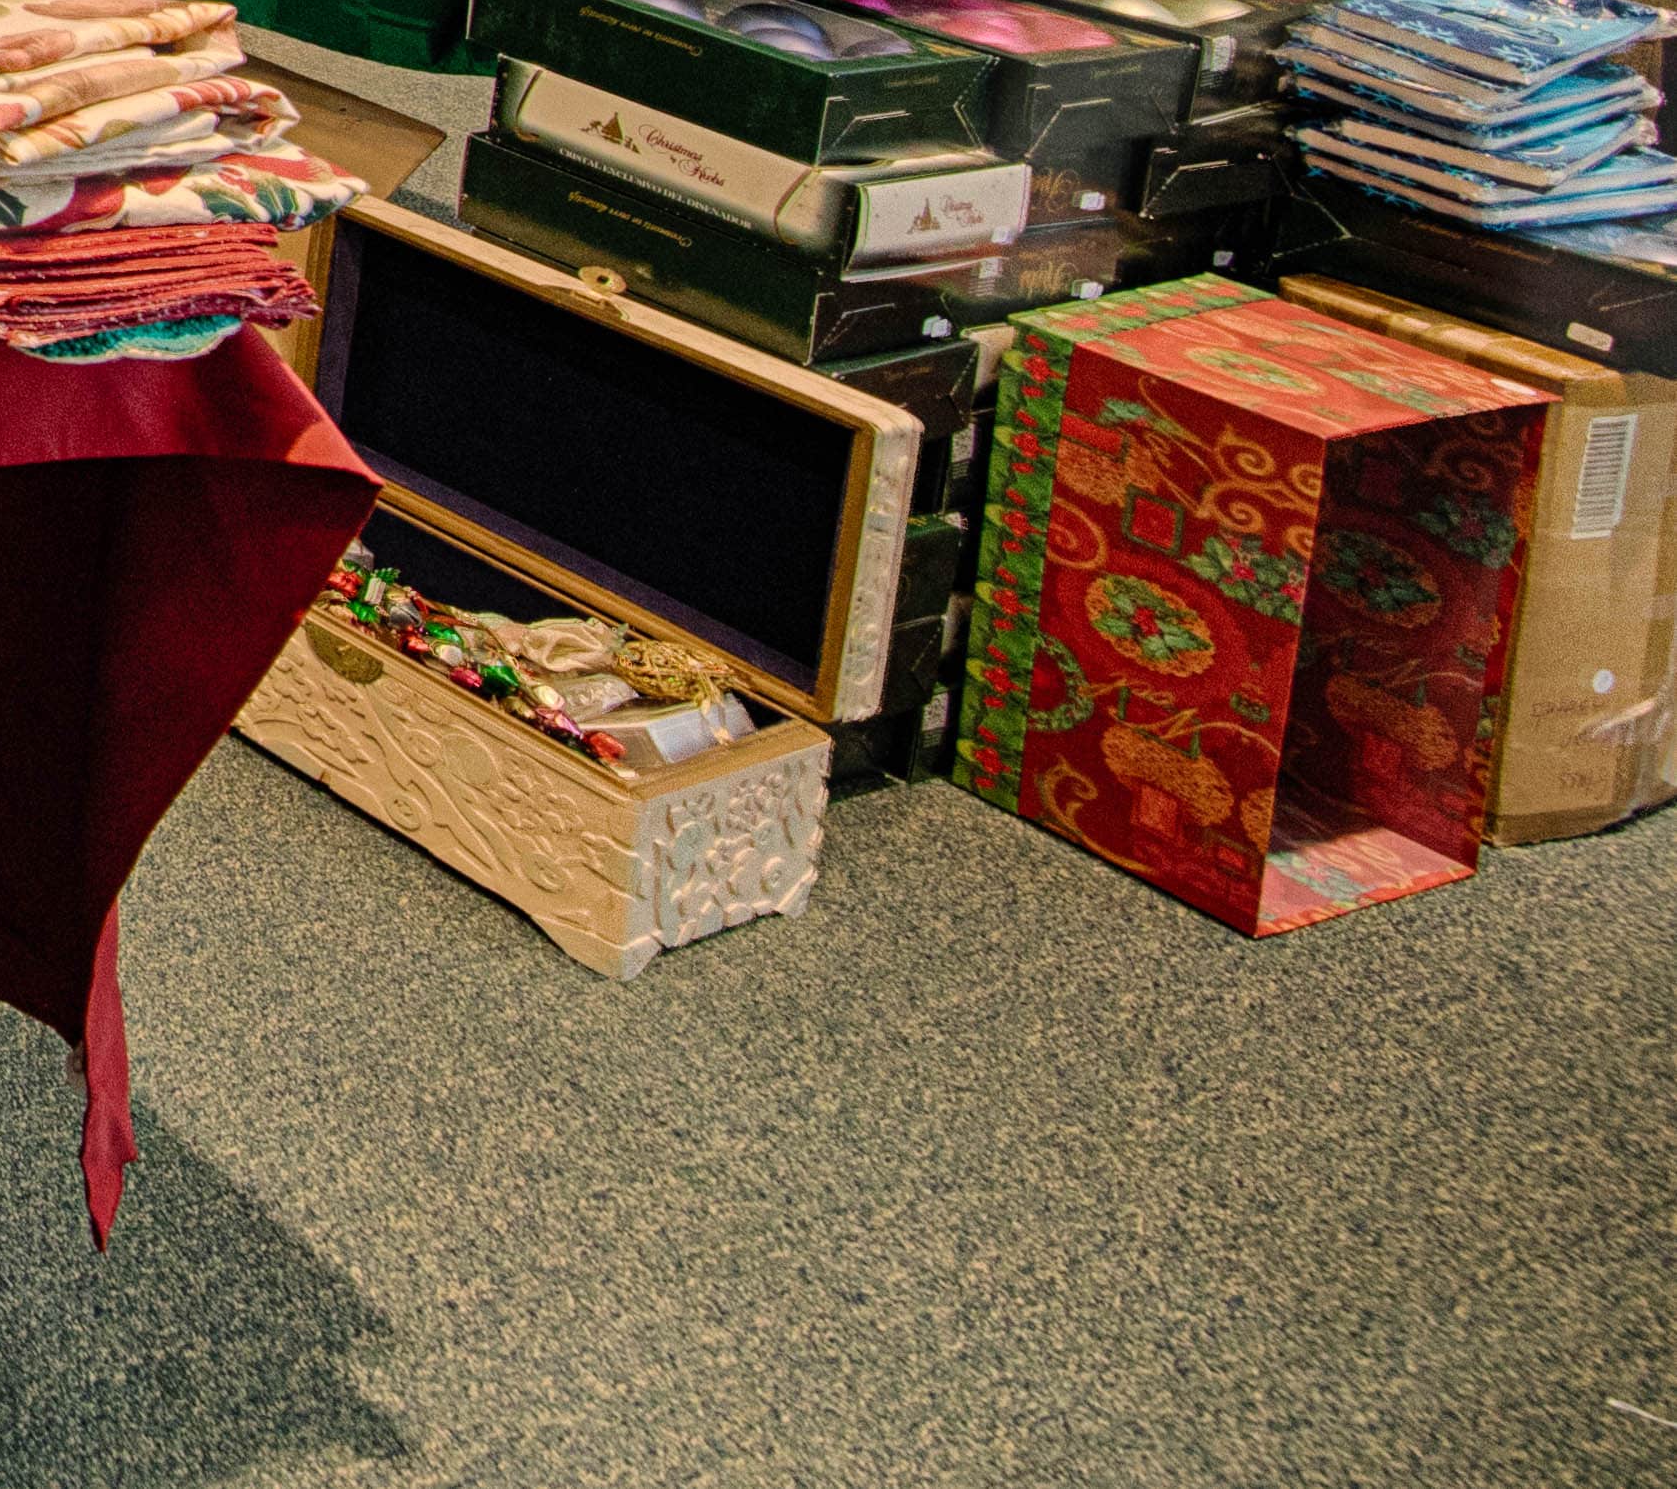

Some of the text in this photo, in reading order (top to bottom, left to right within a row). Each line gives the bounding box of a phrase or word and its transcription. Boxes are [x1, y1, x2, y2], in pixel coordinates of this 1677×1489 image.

[638, 125, 704, 162] Christmas
[559, 147, 603, 172] CRISTAL
[603, 163, 662, 193] EXCLUSIVO
[663, 185, 687, 204] DEL
